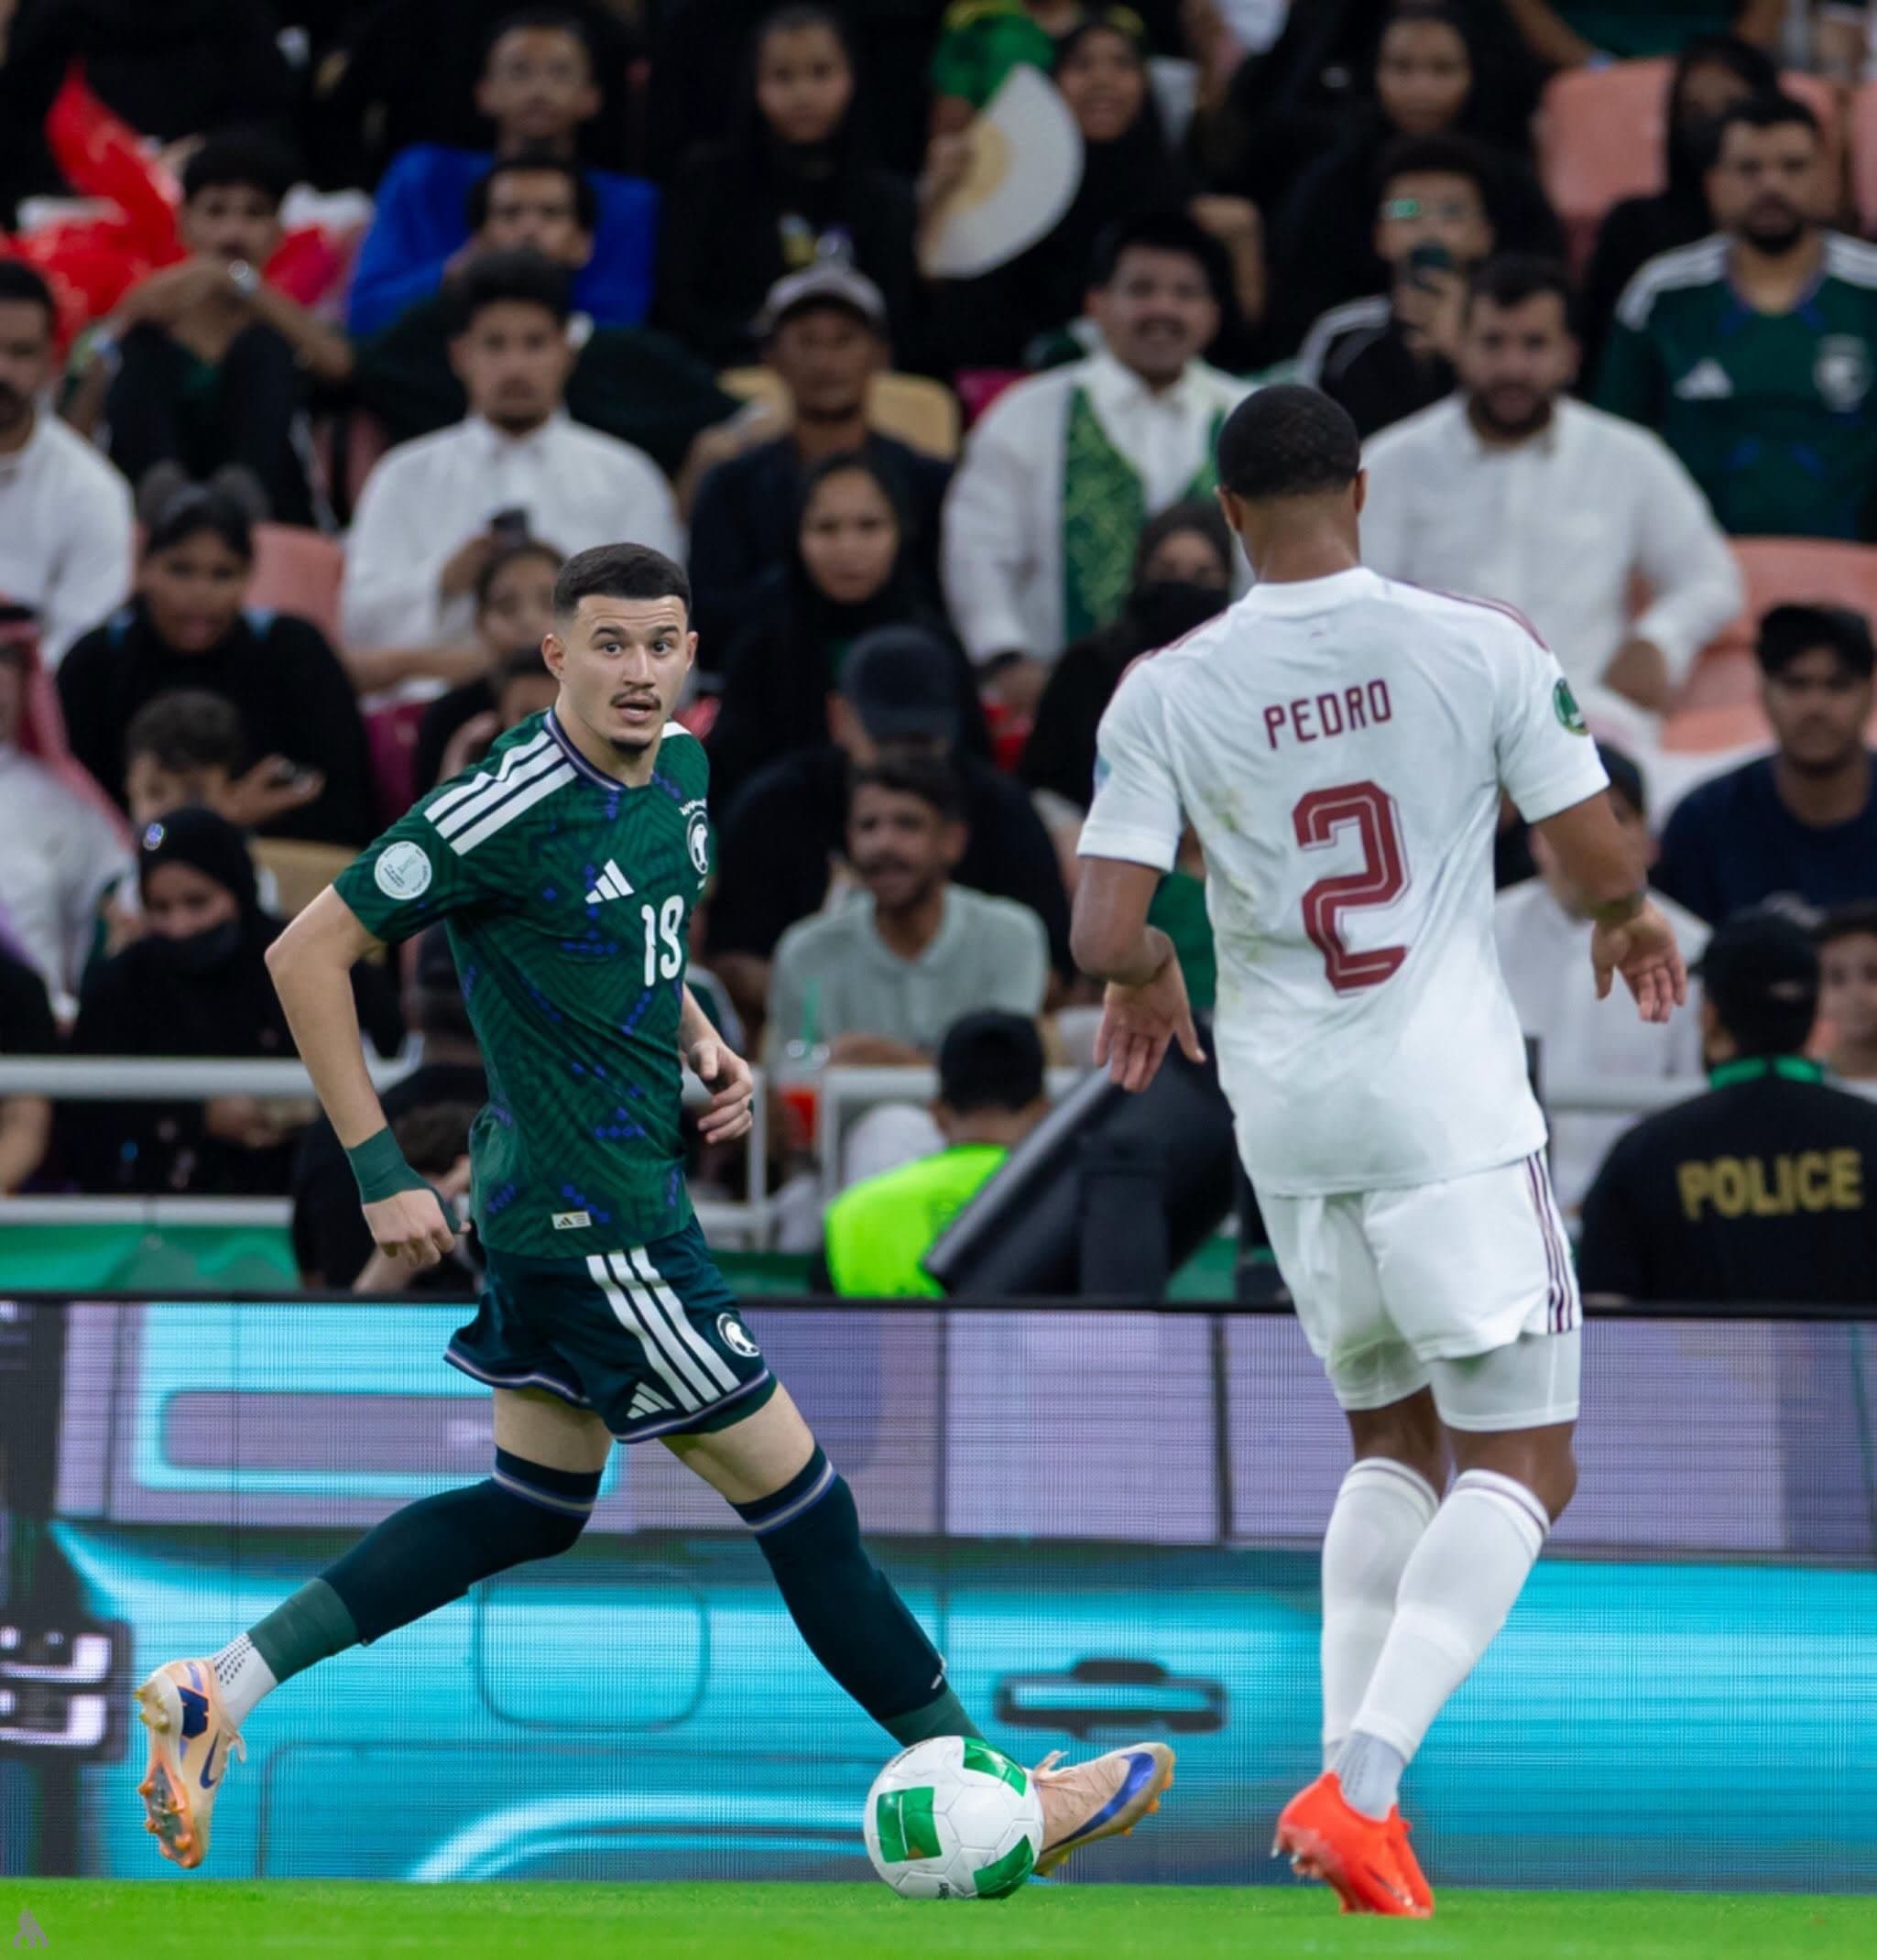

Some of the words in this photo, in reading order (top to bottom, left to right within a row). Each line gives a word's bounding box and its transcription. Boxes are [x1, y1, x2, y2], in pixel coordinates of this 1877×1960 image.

[1263, 679, 1392, 751] PEDRO
[1293, 779, 1412, 997] 2
[641, 894, 684, 986] 19
[1677, 1149, 1862, 1221] POLICE
